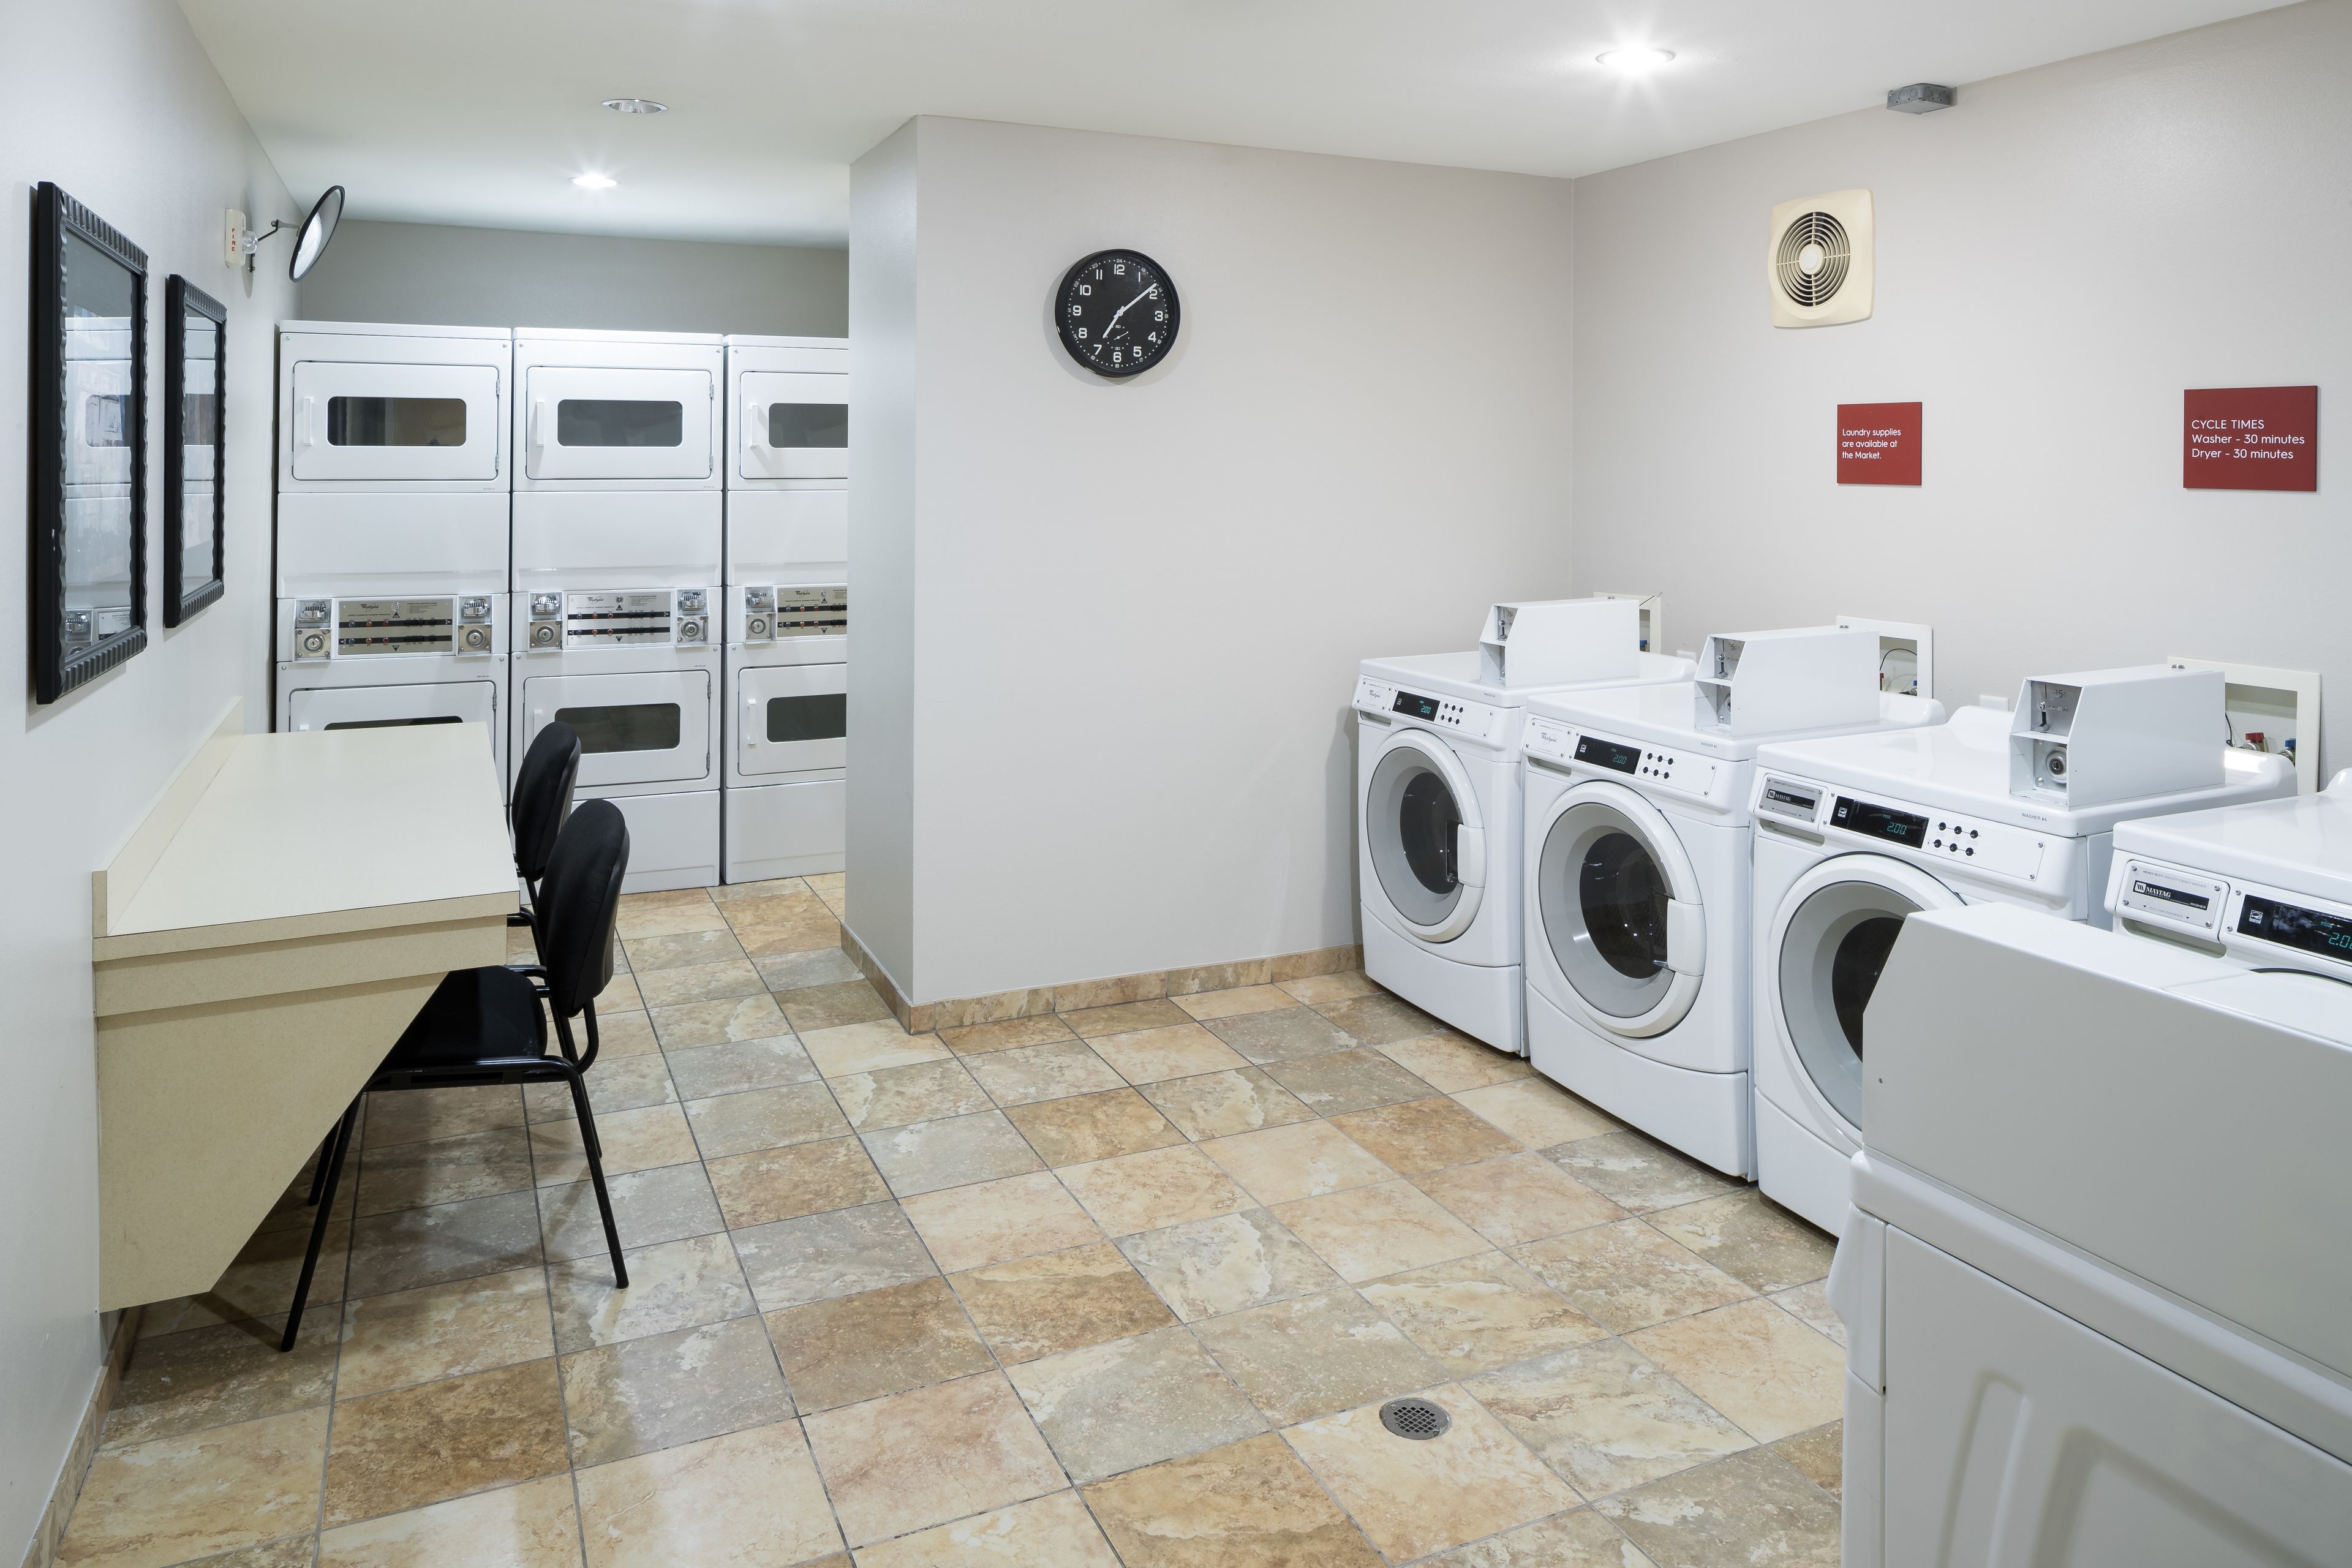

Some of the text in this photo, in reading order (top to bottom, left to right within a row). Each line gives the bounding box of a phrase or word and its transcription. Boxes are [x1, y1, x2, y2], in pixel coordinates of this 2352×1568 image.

[1096, 270, 1102, 280] 11
[1114, 264, 1125, 275] 12
[1138, 272, 1140, 282] 1
[1080, 284, 1091, 296] 10
[1149, 289, 1158, 300] 2
[1072, 305, 1082, 316] 9
[1155, 311, 1163, 322] 3
[1078, 327, 1087, 339] 8
[1148, 331, 1156, 342] 4
[1094, 344, 1102, 355] 7
[1133, 346, 1142, 357] 5
[1113, 352, 1121, 363] 6
[2192, 420, 2264, 429] CYCLE TIMES
[1842, 428, 1901, 437] Laundry supplies
[2192, 434, 2232, 444] Washer
[2244, 434, 2258, 444] 30
[2261, 434, 2305, 444] minutes
[2192, 448, 2222, 459] Dryer
[2233, 448, 2247, 458] 30
[2250, 449, 2294, 459] minutes
[1420, 705, 1431, 714] 2.00
[1541, 734, 1557, 743] Whirlpool
[1613, 754, 1627, 764] 2.00
[1774, 793, 1792, 802] MAYTAG
[1887, 822, 1907, 835] 2.00
[2145, 886, 2171, 898] MAYTAG
